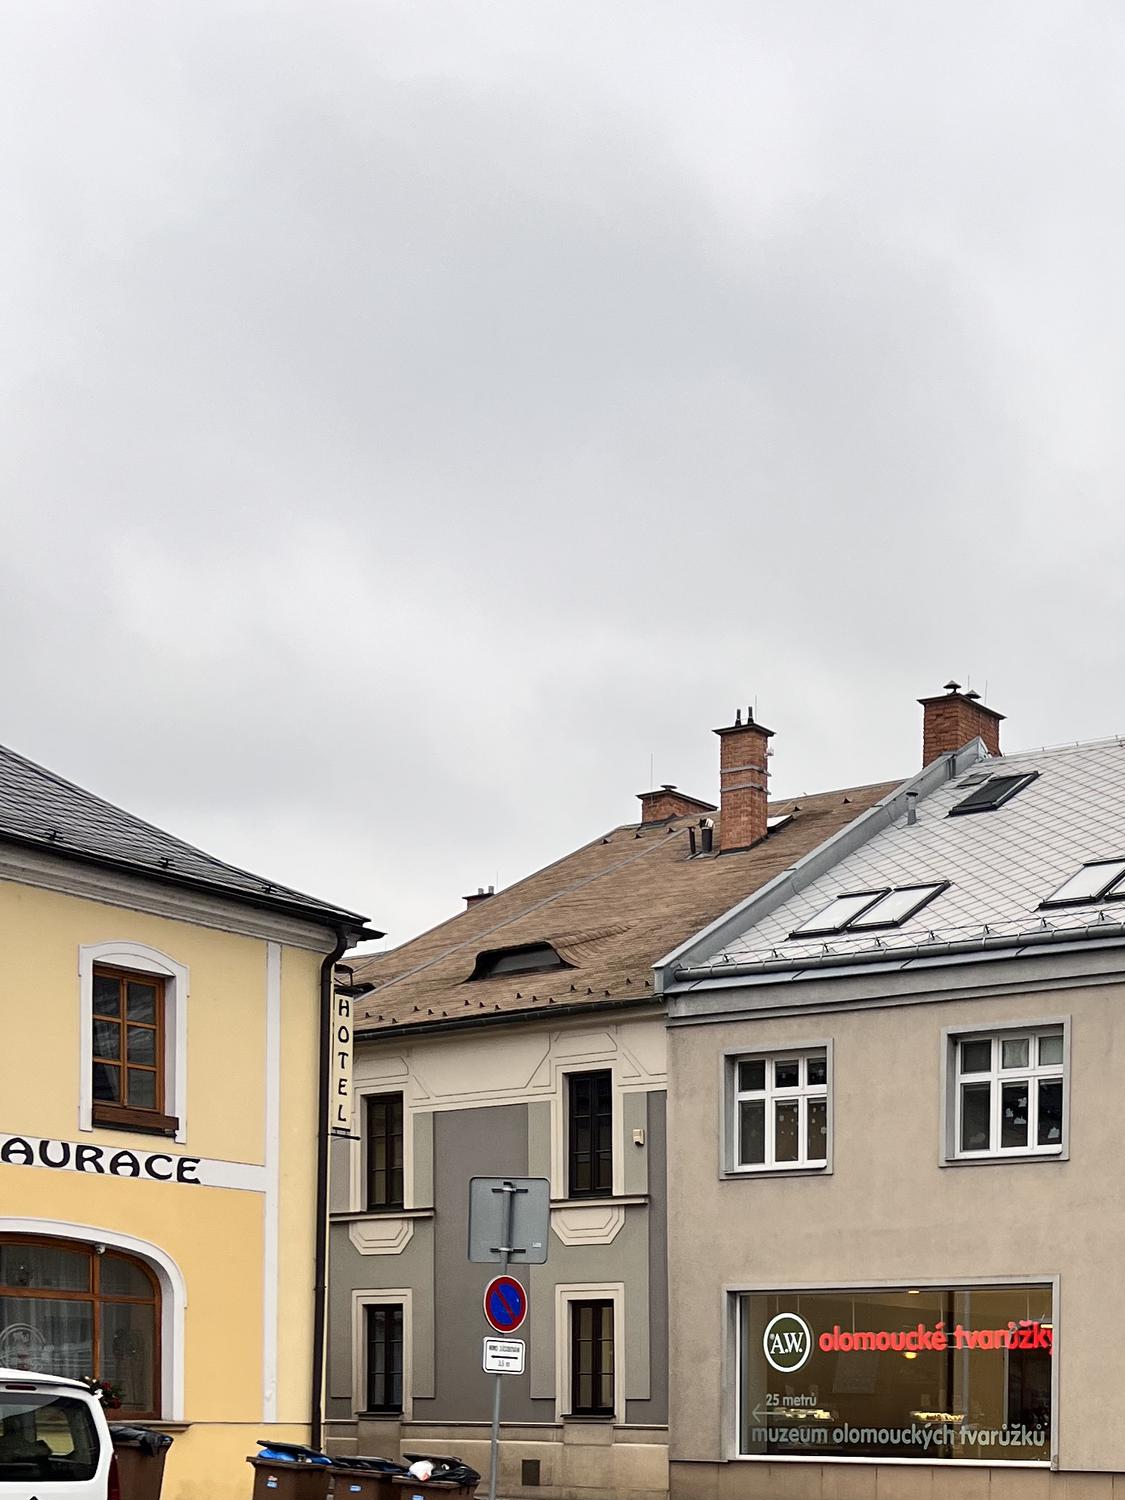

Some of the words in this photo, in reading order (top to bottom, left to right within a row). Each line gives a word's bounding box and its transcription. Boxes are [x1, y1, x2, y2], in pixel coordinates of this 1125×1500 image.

[338, 998, 350, 1122] HOTEL
[1, 1137, 201, 1184] AURACE
[818, 1322, 947, 1352] olomoucké
[765, 1394, 780, 1406] 25
[782, 1393, 817, 1407] metrů
[752, 1427, 828, 1443] muzeum
[832, 1422, 955, 1450] olomouckých
[959, 1423, 1045, 1447] tvarůžků
